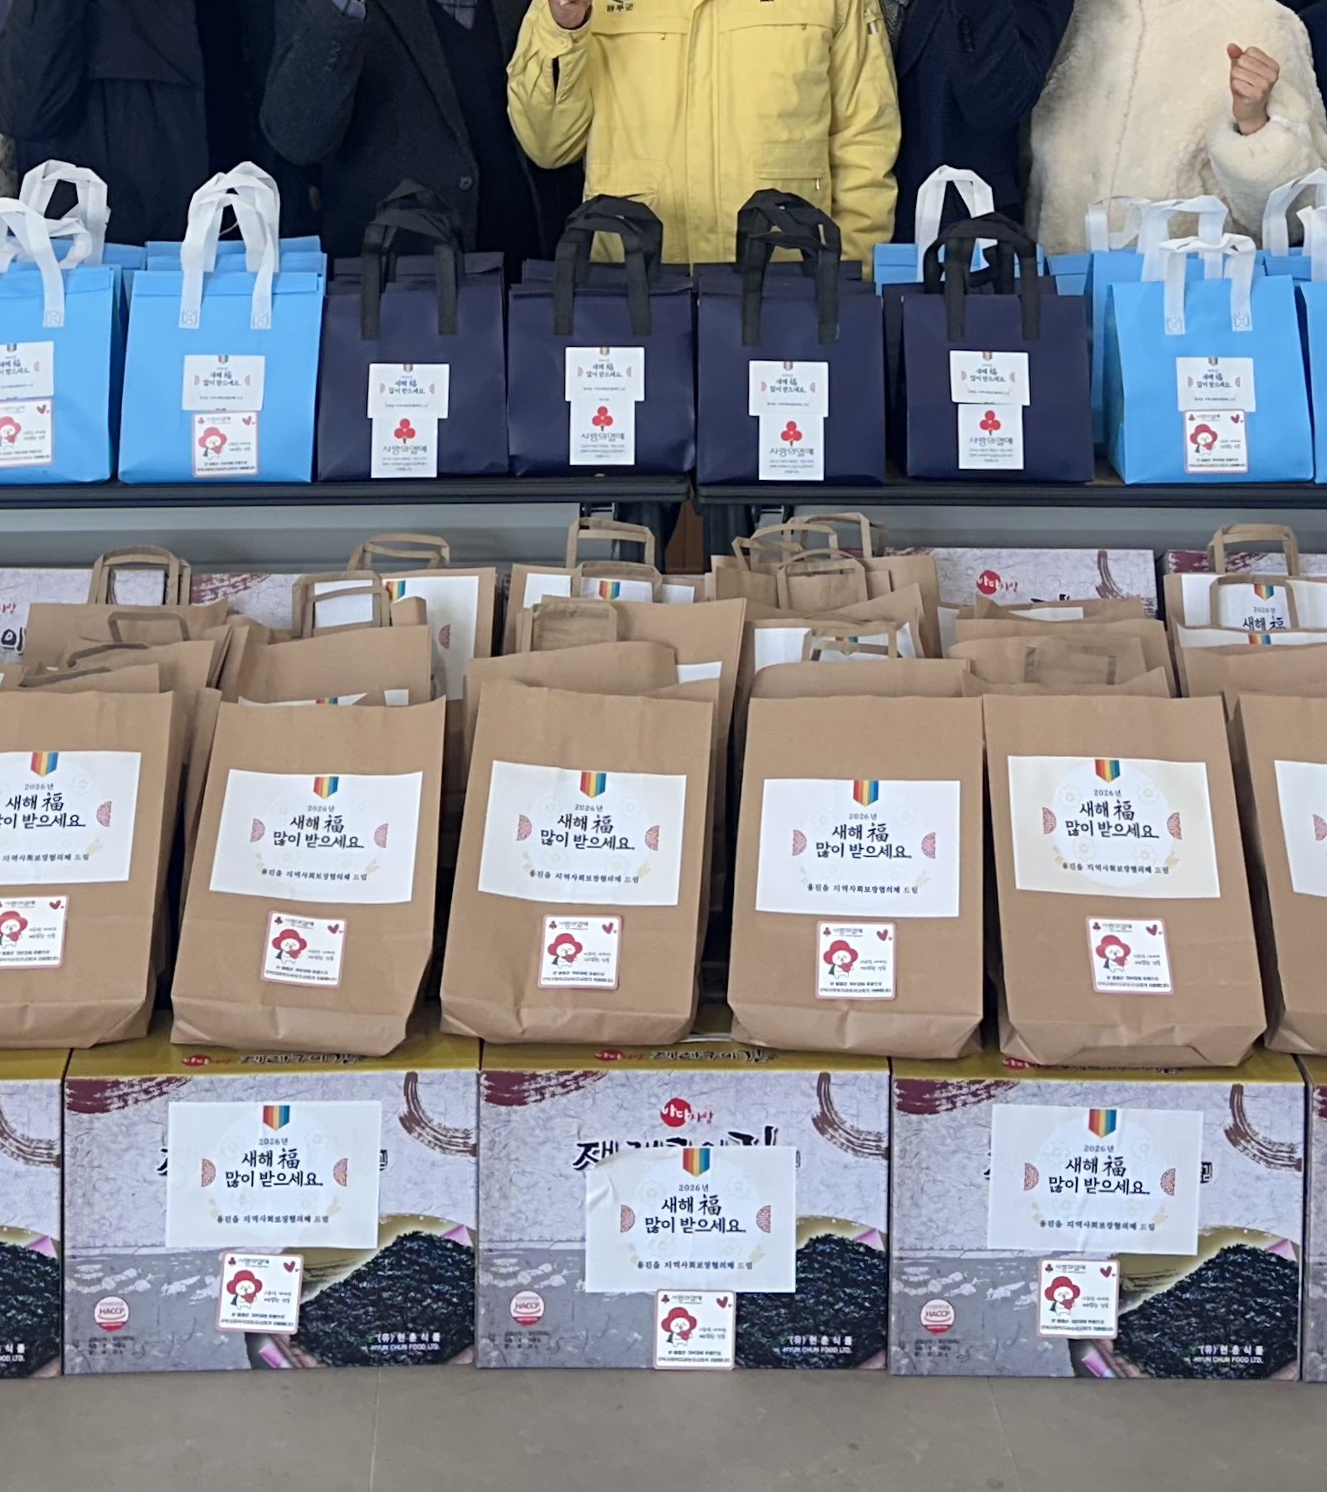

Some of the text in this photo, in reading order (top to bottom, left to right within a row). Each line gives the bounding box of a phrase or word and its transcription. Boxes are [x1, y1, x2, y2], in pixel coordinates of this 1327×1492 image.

[5, 791, 64, 811] 새해 福
[1079, 799, 1135, 820] 새해 福
[21, 813, 86, 829] 받으세요.
[290, 814, 345, 834] 새해 福
[557, 813, 613, 834] 새해 福
[1065, 819, 1159, 839] 많이 받으세요.
[273, 831, 364, 849] 많이 받으세요.
[540, 829, 636, 852] 많이 받으세요.
[832, 822, 889, 843] 새해 福
[815, 841, 913, 860] 많이 받으세요.
[259, 1138, 288, 1146] 2026년
[1084, 1144, 1114, 1152] 2026년
[242, 1148, 299, 1169] 새해 福
[1066, 1155, 1126, 1177] 새해 福
[225, 1170, 323, 1188] 많이 받으세요.
[679, 1184, 709, 1192] 2026년
[1048, 1177, 1150, 1195] 많이 받으세요.
[662, 1194, 721, 1216] 새해 福
[645, 1216, 746, 1234] 많이 받으세요.
